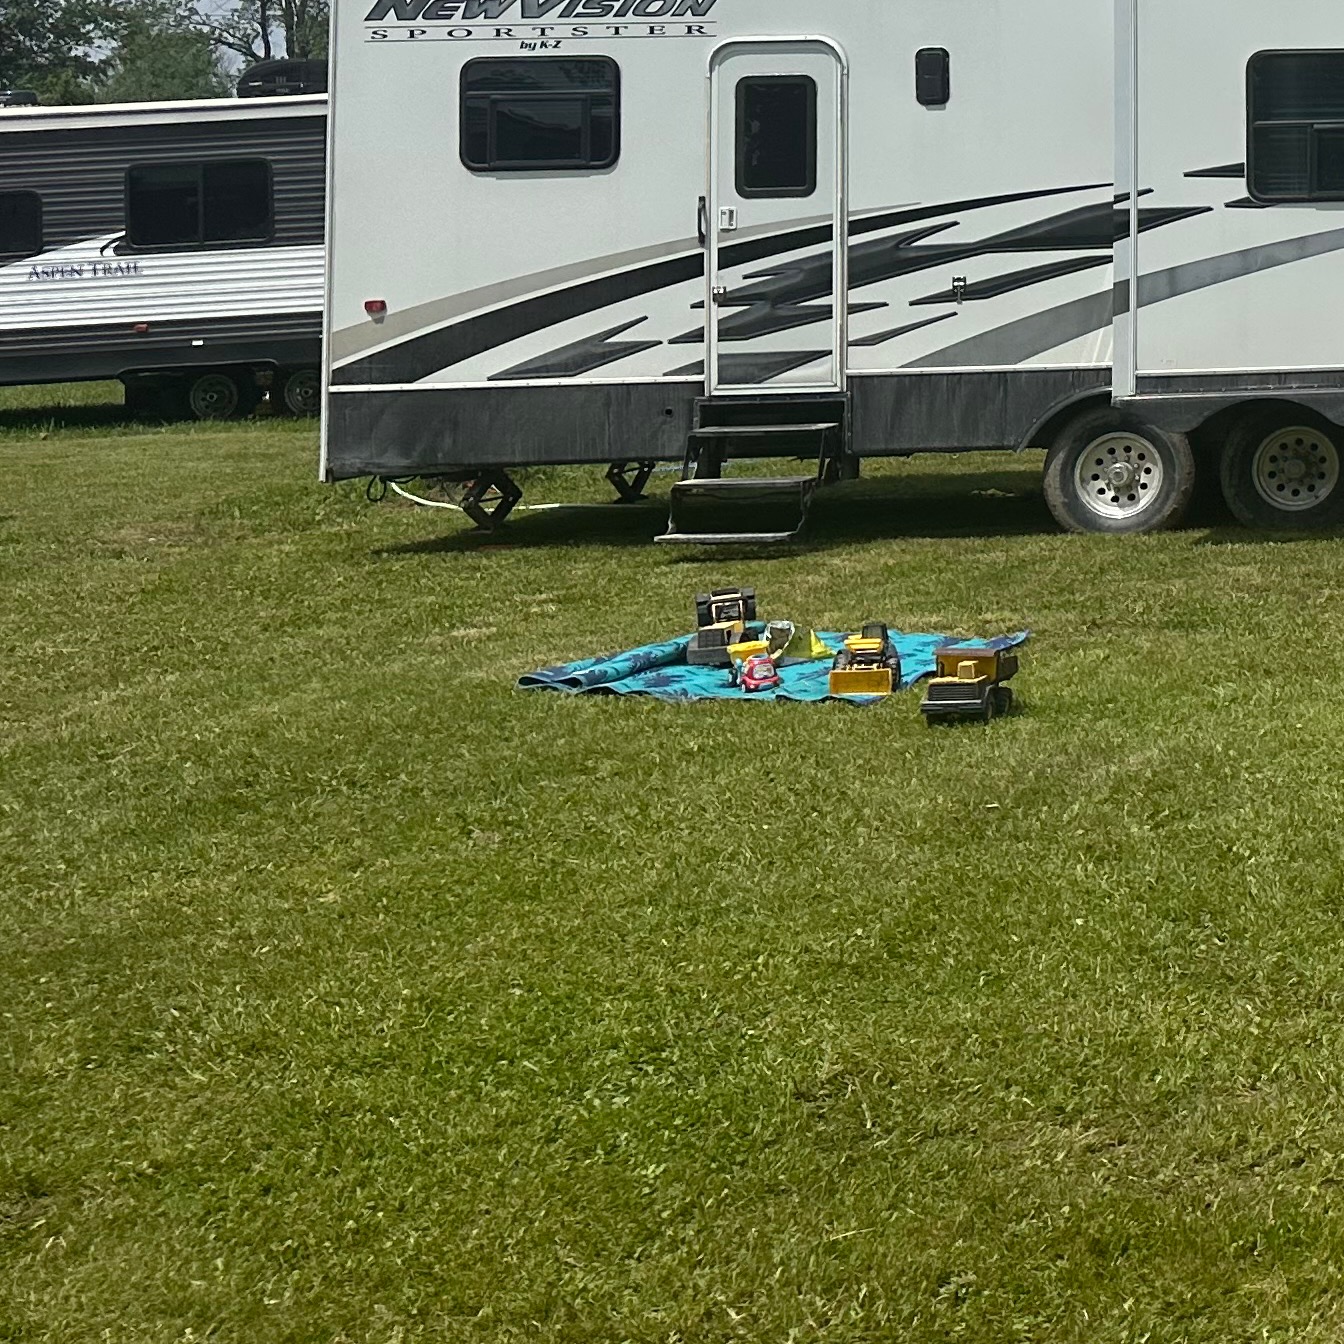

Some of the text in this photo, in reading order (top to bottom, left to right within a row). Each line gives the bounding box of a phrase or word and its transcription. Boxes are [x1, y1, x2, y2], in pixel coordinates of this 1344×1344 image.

[370, 25, 709, 40] SPORTSTER
[520, 40, 562, 51] by K-Z
